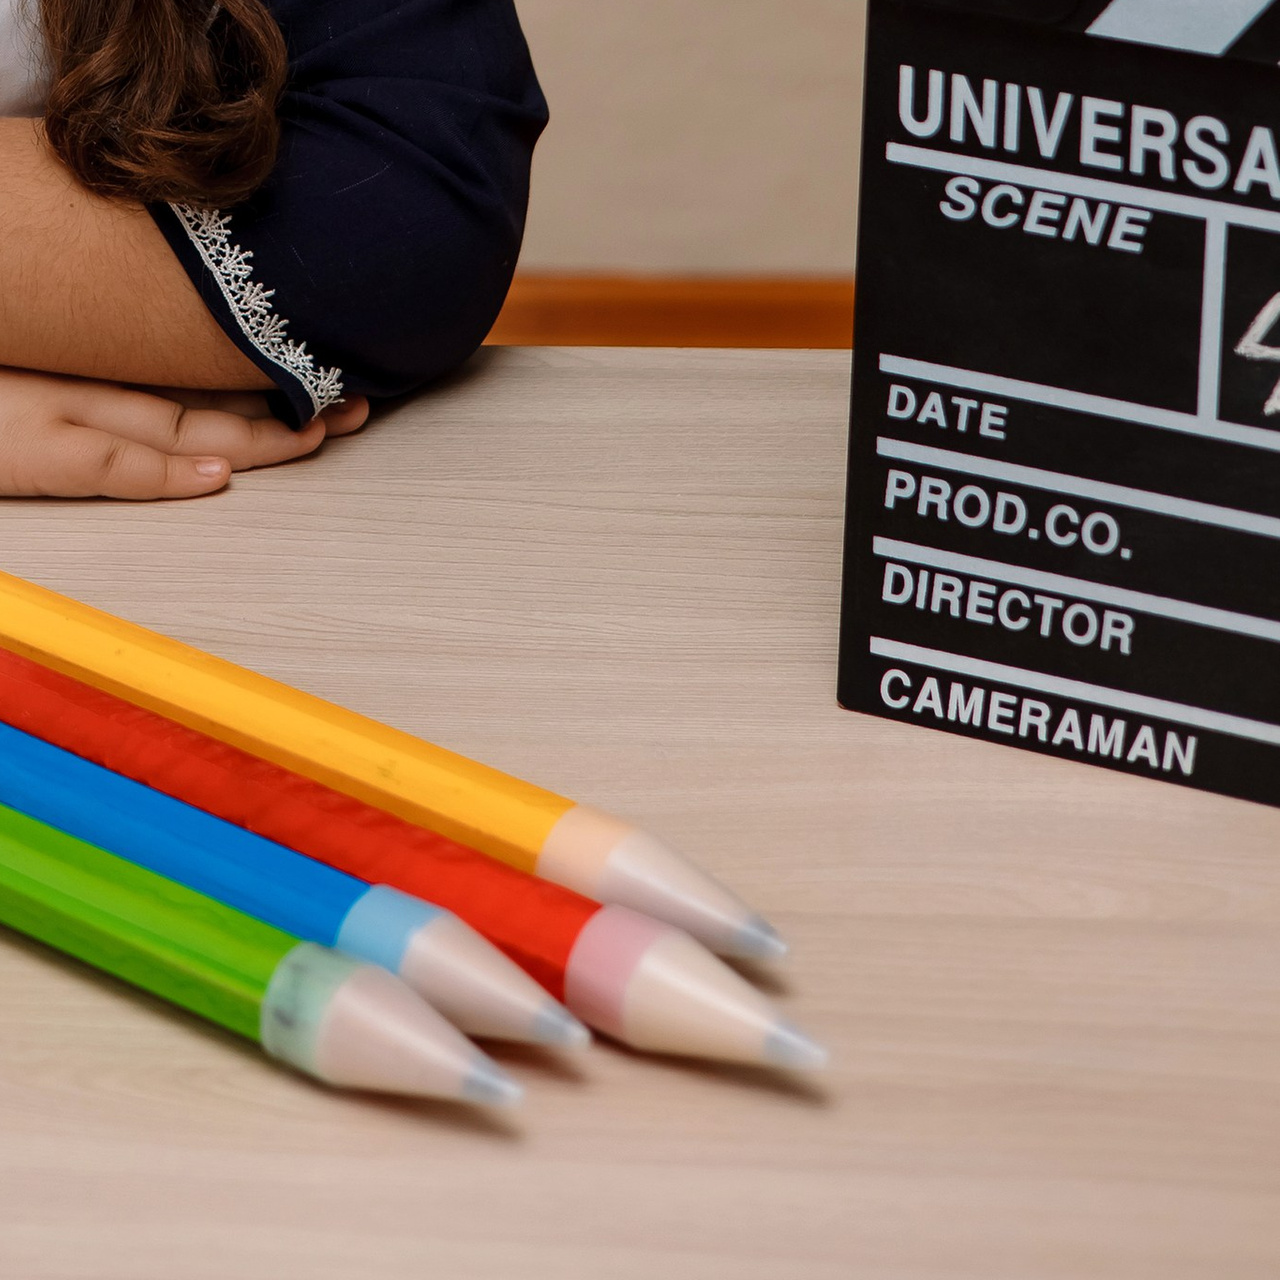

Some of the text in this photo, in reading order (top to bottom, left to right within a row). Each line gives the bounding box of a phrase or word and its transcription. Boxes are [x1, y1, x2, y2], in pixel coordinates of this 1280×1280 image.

[939, 176, 1153, 253] SCENE
[886, 384, 1008, 440] DATE
[883, 469, 1133, 560] PROD.CO.
[881, 561, 1136, 656] DIRECTOR
[879, 668, 1198, 776] CAMERAMAN
